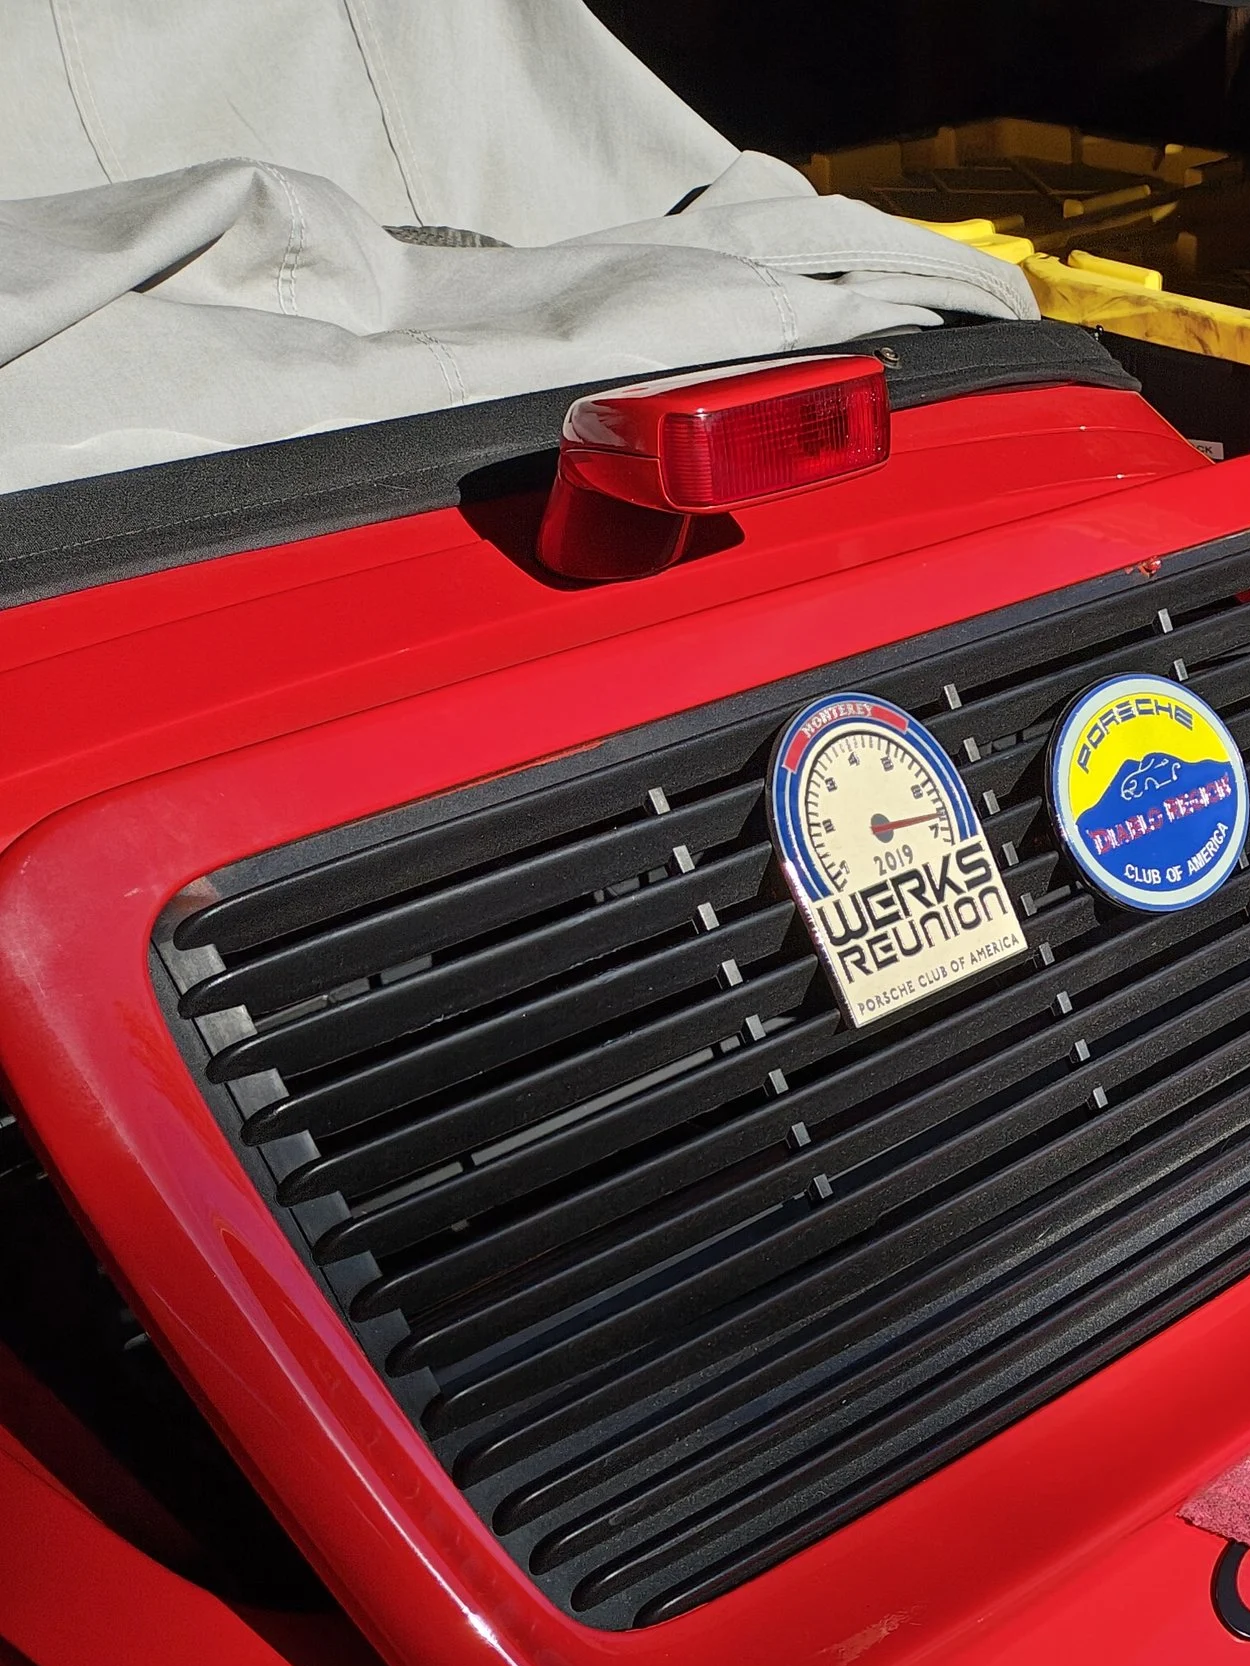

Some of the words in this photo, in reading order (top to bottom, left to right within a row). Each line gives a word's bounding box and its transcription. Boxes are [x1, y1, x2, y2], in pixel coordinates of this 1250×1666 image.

[801, 702, 874, 738] MONTEREY
[1077, 698, 1193, 774] PORSCHE
[1086, 808, 1164, 855] DIABLO
[1163, 772, 1232, 822] REGION
[873, 844, 914, 877] 2019
[1124, 863, 1161, 884] CLUB
[1165, 865, 1184, 883] OF
[1186, 822, 1229, 877] AMERICA
[816, 840, 993, 947] WERKS
[857, 979, 916, 1016] PORSCHE
[917, 965, 949, 988] CLUB
[950, 956, 966, 973] OF
[970, 933, 1020, 966] AMERICA
